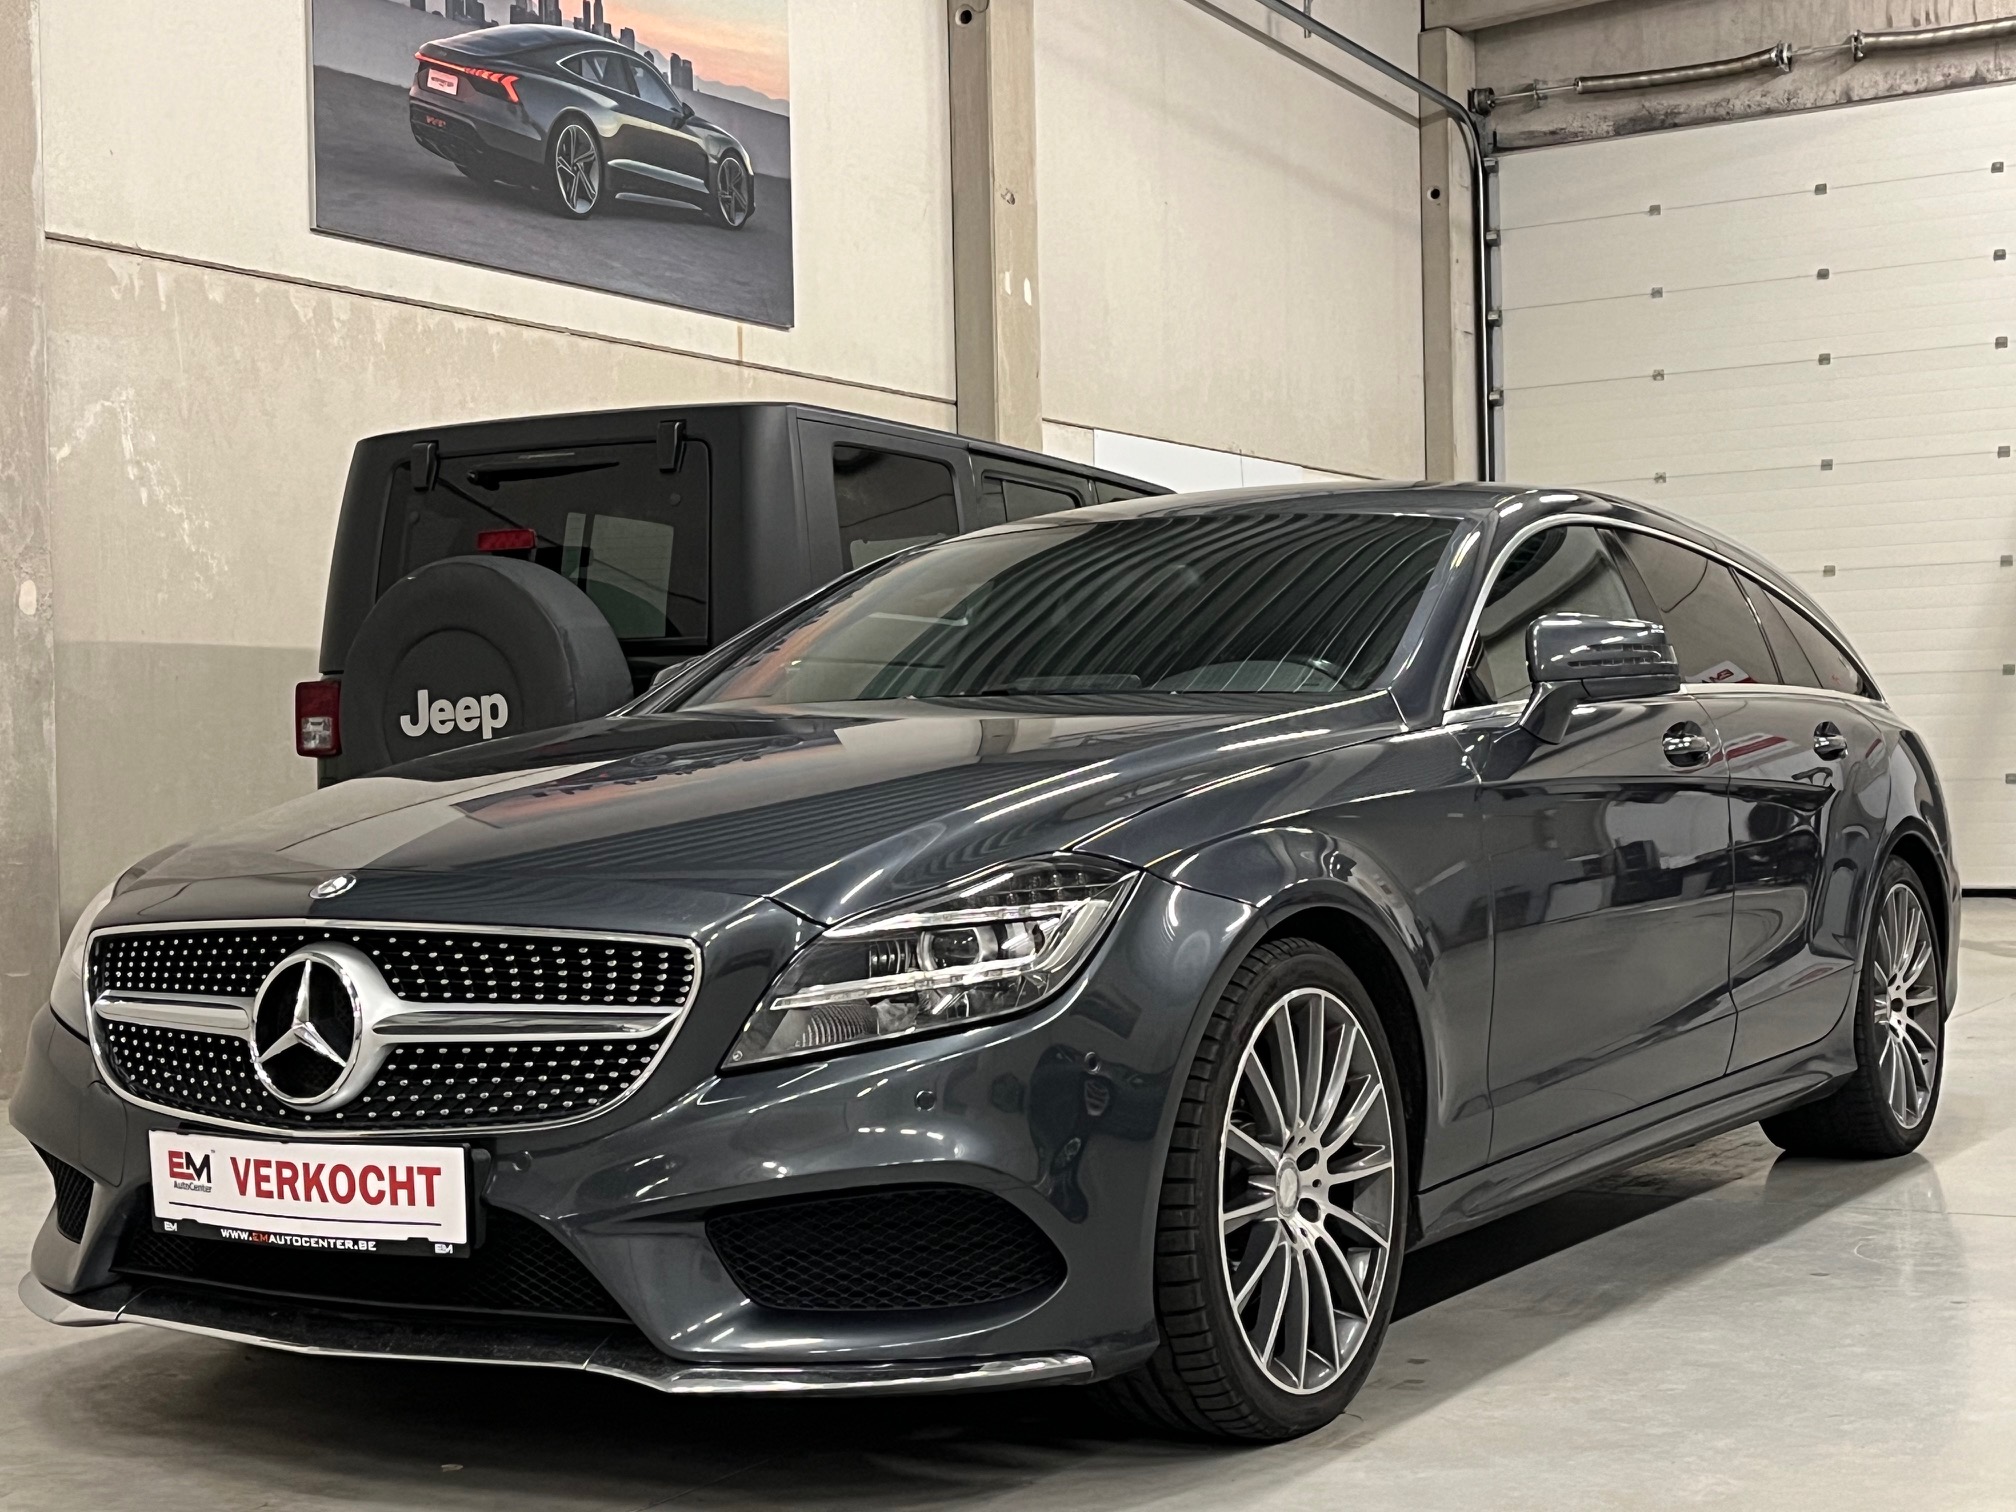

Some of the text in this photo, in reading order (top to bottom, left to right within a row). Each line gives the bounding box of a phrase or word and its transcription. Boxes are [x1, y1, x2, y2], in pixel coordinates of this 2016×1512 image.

[400, 689, 508, 739] Jeep
[168, 1151, 212, 1183] EM
[230, 1156, 442, 1207] VERKOCHT
[173, 1180, 212, 1193] AutoCenter
[220, 1228, 377, 1251] WWW.EMAUTOCENTER.BE
